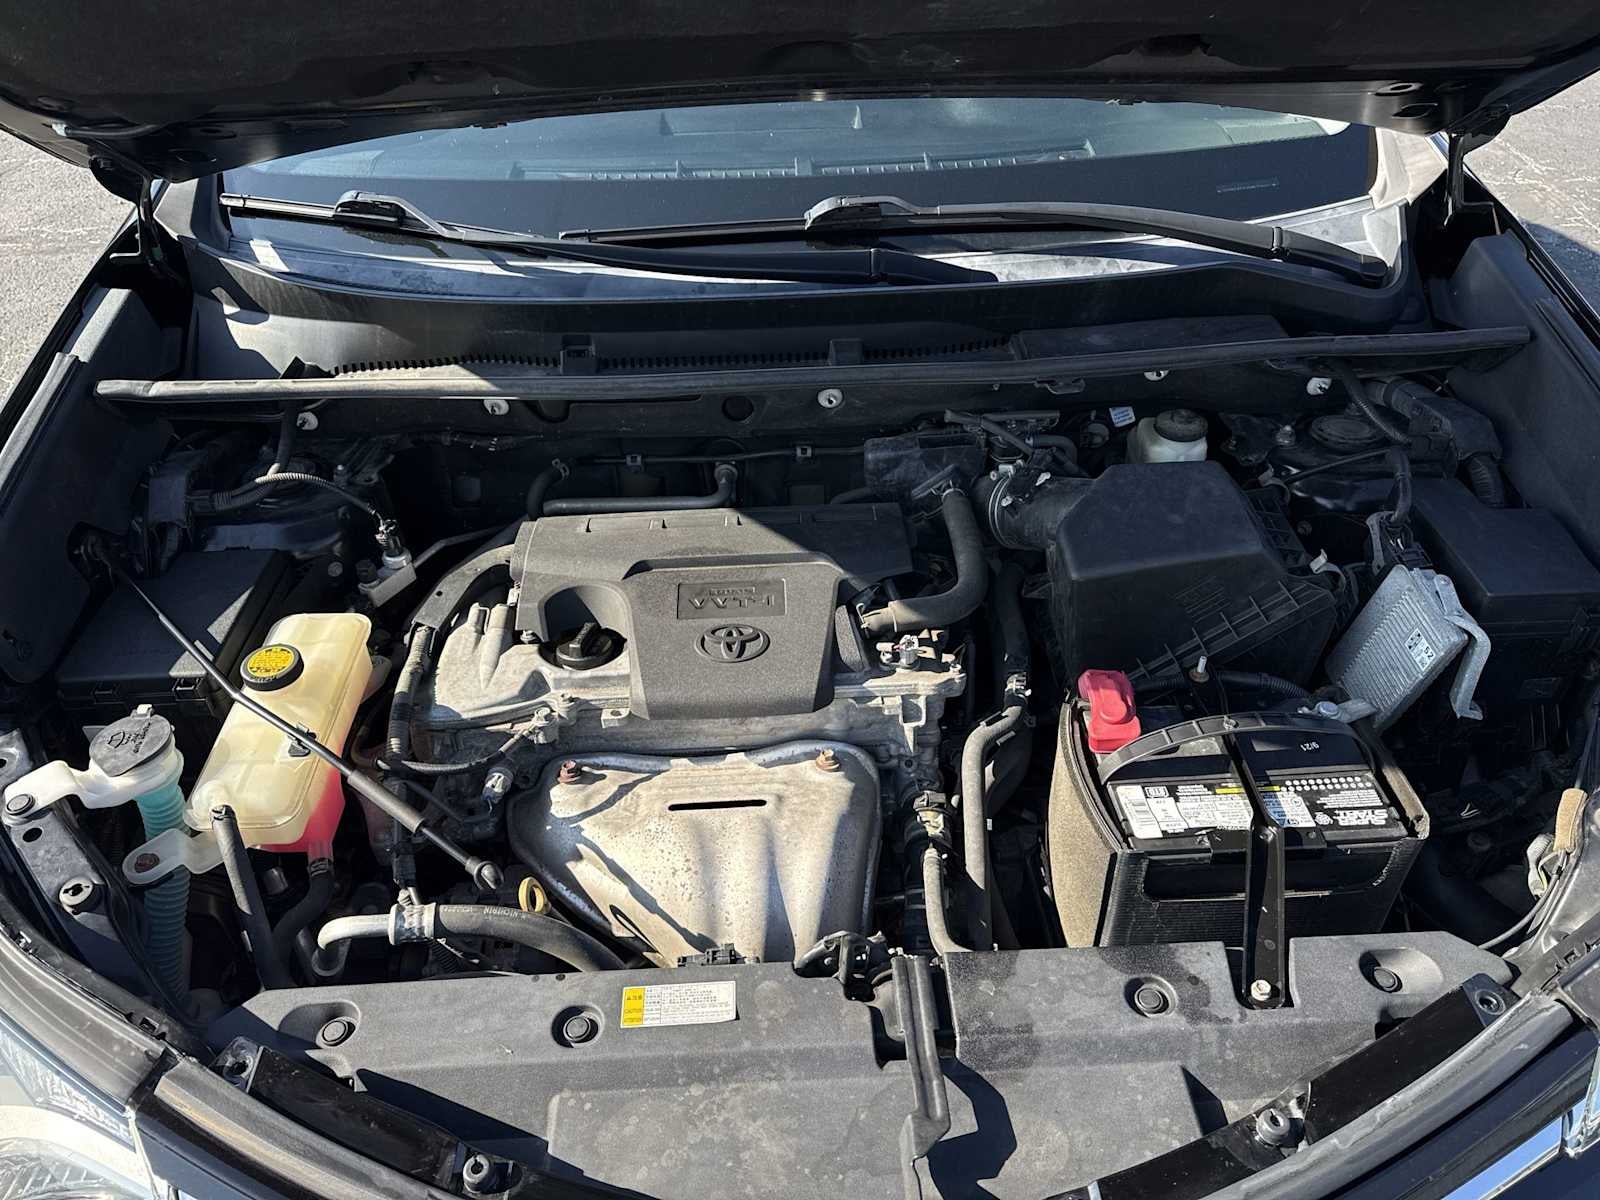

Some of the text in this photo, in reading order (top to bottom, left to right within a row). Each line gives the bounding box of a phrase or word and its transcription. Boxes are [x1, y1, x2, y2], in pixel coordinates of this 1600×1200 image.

[1300, 741, 1320, 752] 9/21
[1335, 809, 1388, 819] START
[1337, 817, 1386, 827] SUPER
